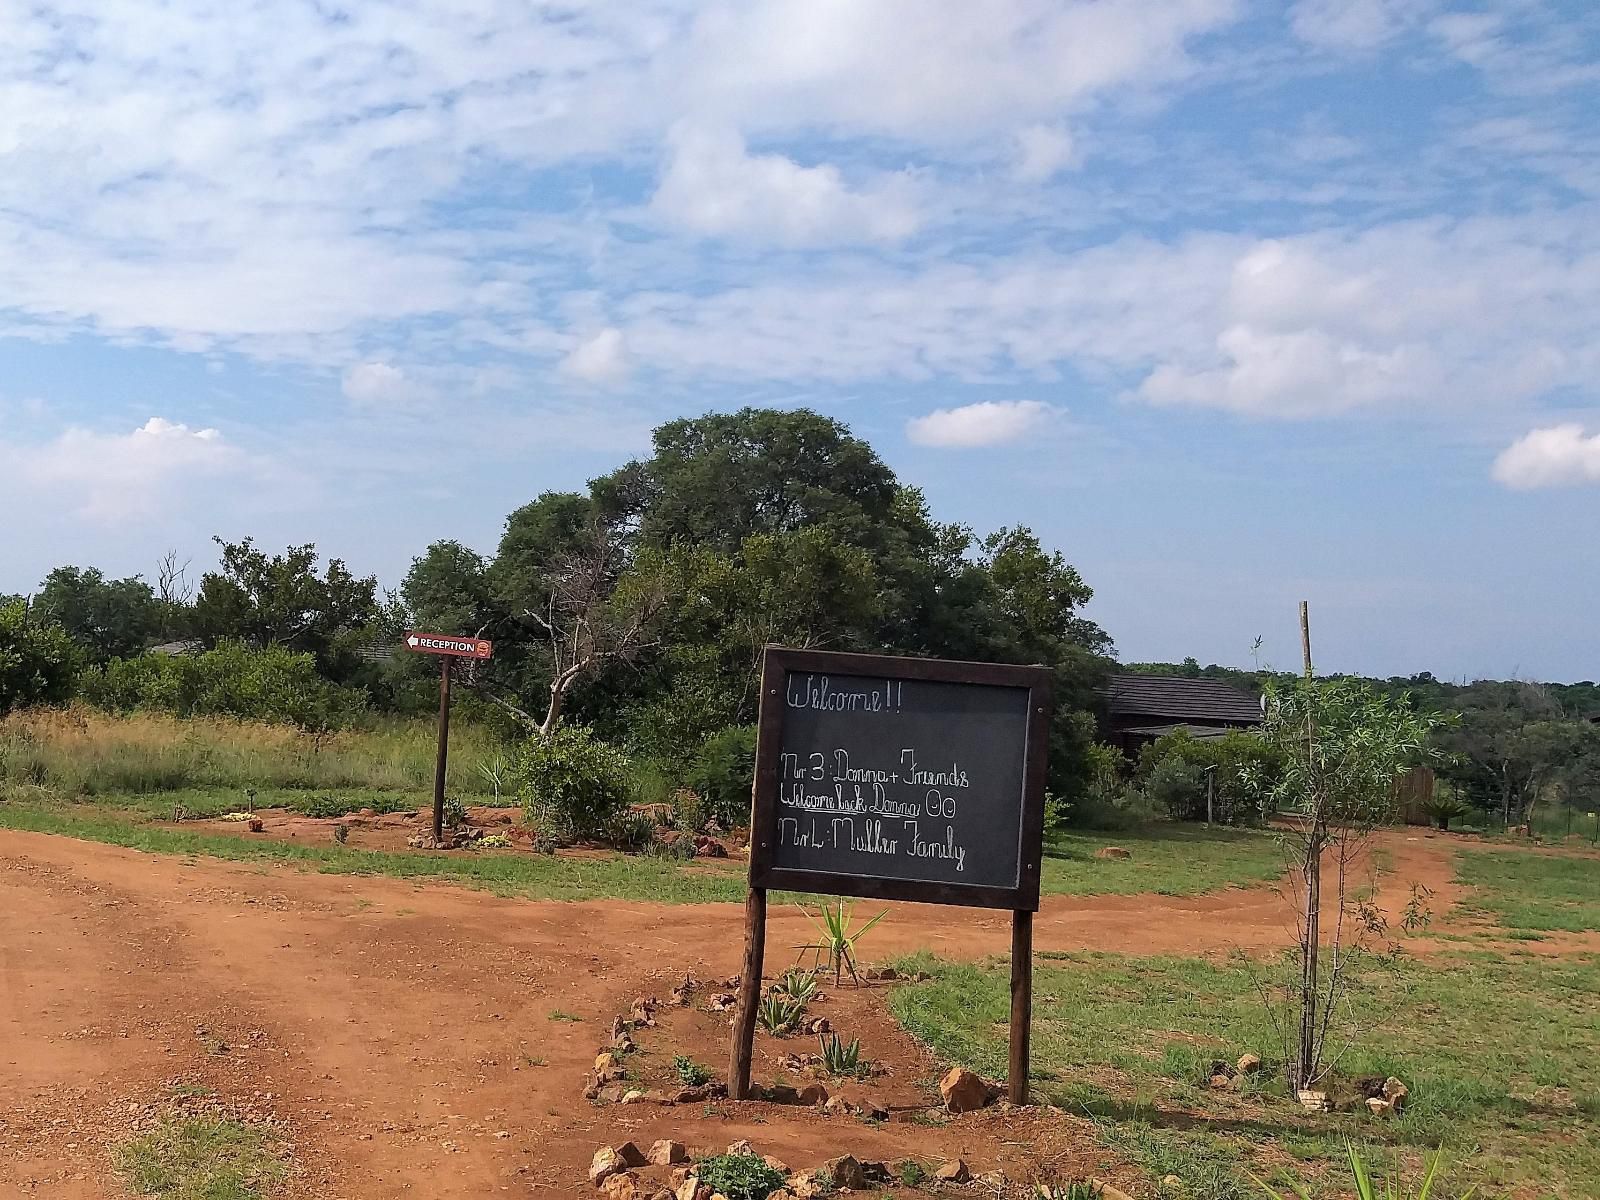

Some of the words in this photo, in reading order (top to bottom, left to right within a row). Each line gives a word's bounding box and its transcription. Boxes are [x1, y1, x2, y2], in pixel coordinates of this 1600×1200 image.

[420, 638, 475, 652] RECEPTION
[780, 782, 835, 809] Welcome
[835, 783, 867, 812] back
[868, 782, 921, 816] Donna
[903, 820, 966, 872] Family
